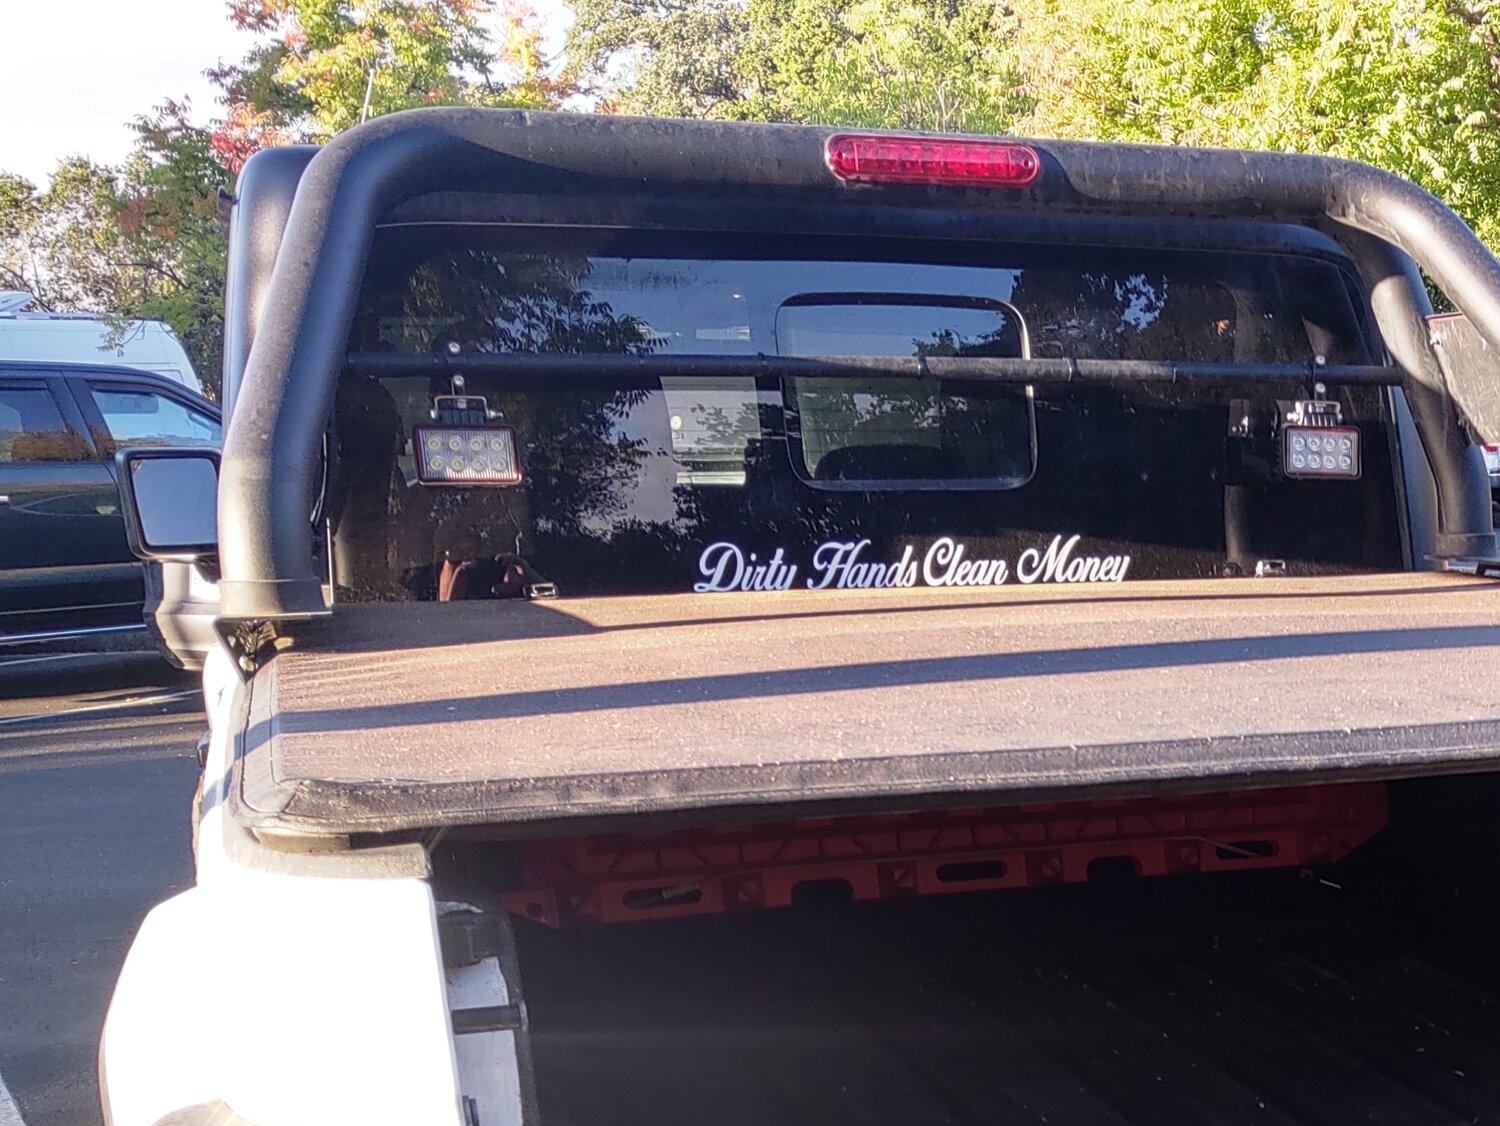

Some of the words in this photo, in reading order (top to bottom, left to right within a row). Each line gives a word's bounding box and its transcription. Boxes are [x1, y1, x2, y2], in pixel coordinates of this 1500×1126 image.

[694, 542, 798, 593] Dirty
[806, 539, 918, 589] Hands
[922, 537, 1009, 587] Clean
[1016, 534, 1130, 582] Money
